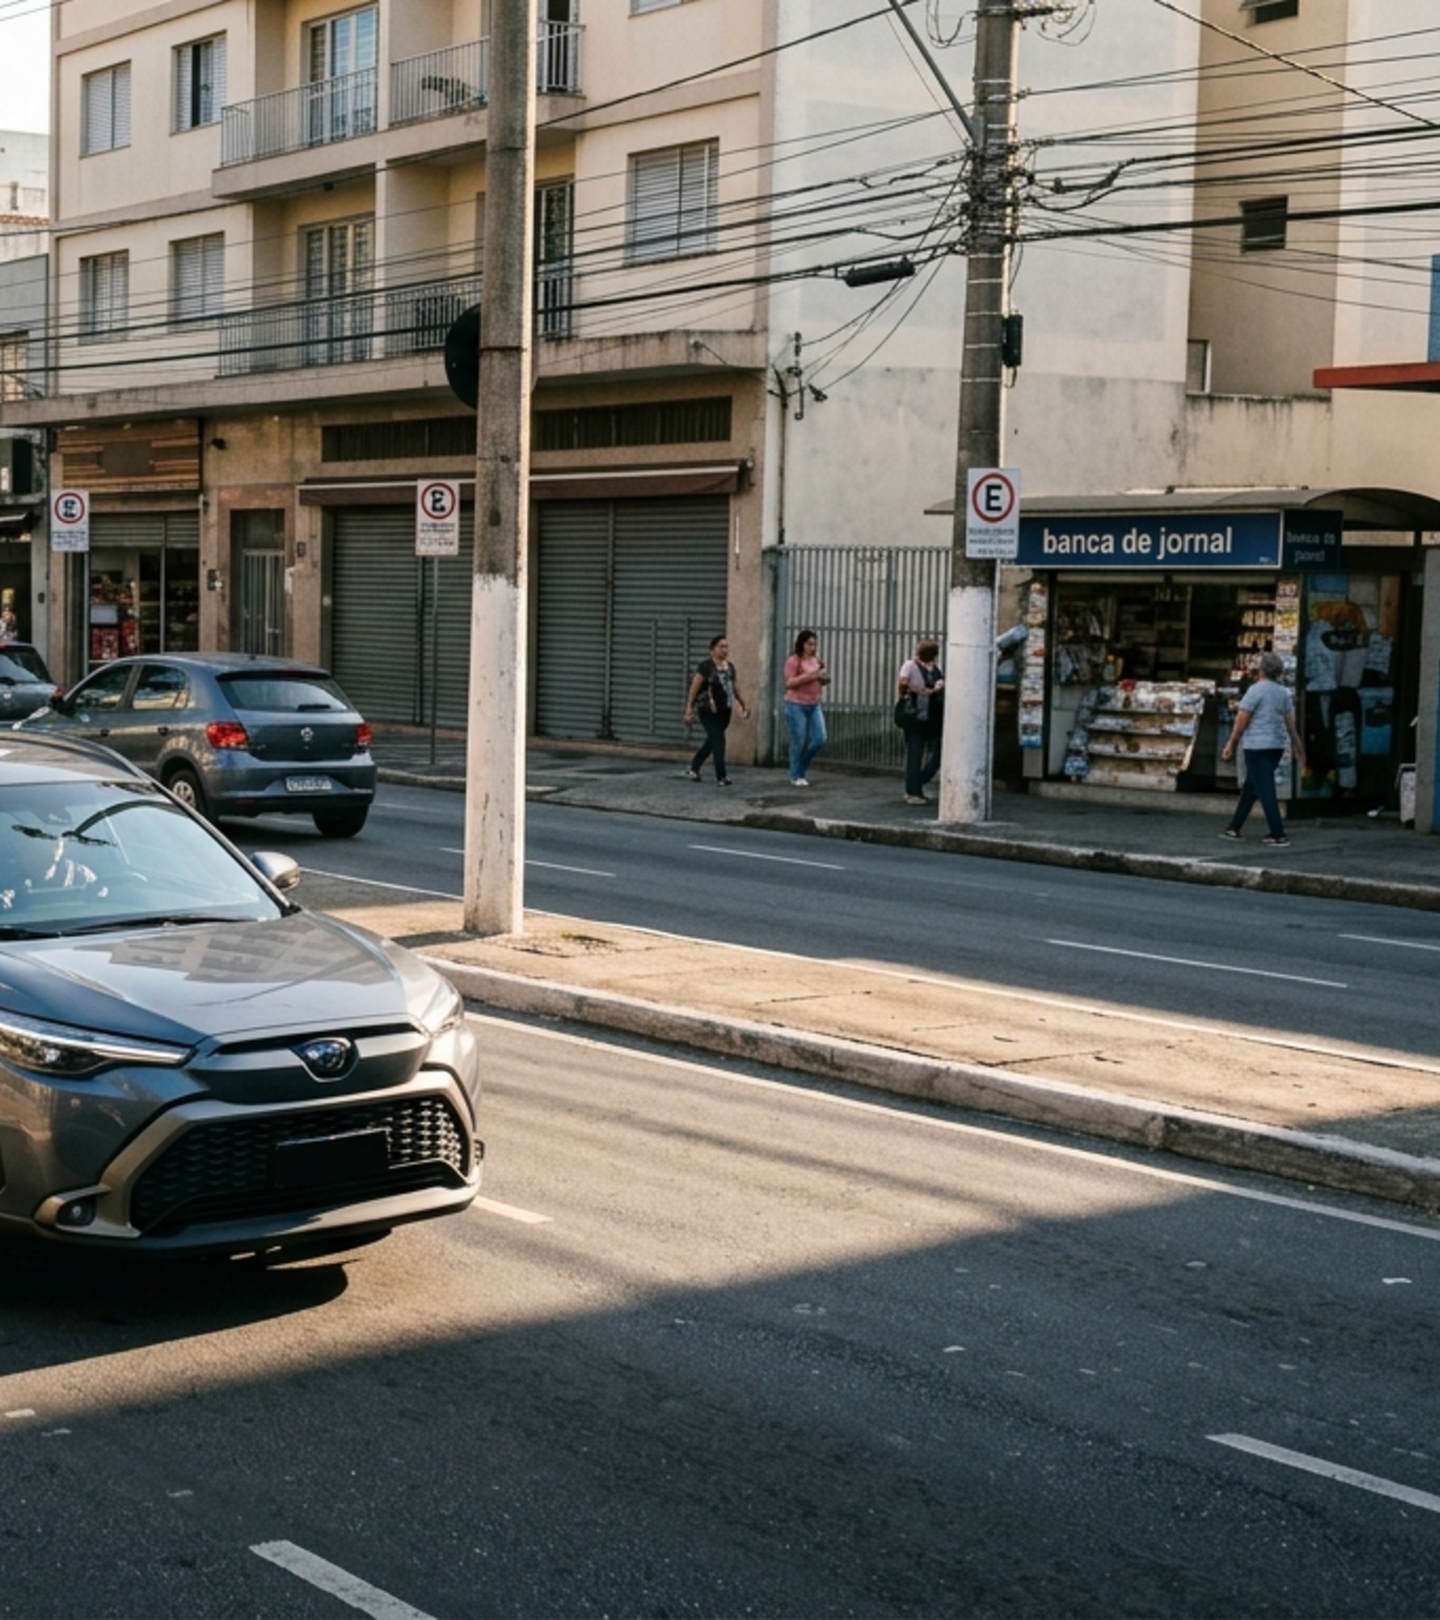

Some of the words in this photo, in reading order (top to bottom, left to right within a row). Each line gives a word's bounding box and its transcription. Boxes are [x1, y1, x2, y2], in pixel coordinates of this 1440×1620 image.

[985, 484, 1003, 511] E
[1043, 527, 1115, 554] banca
[1121, 526, 1152, 554] de
[1156, 526, 1233, 560] jornal
